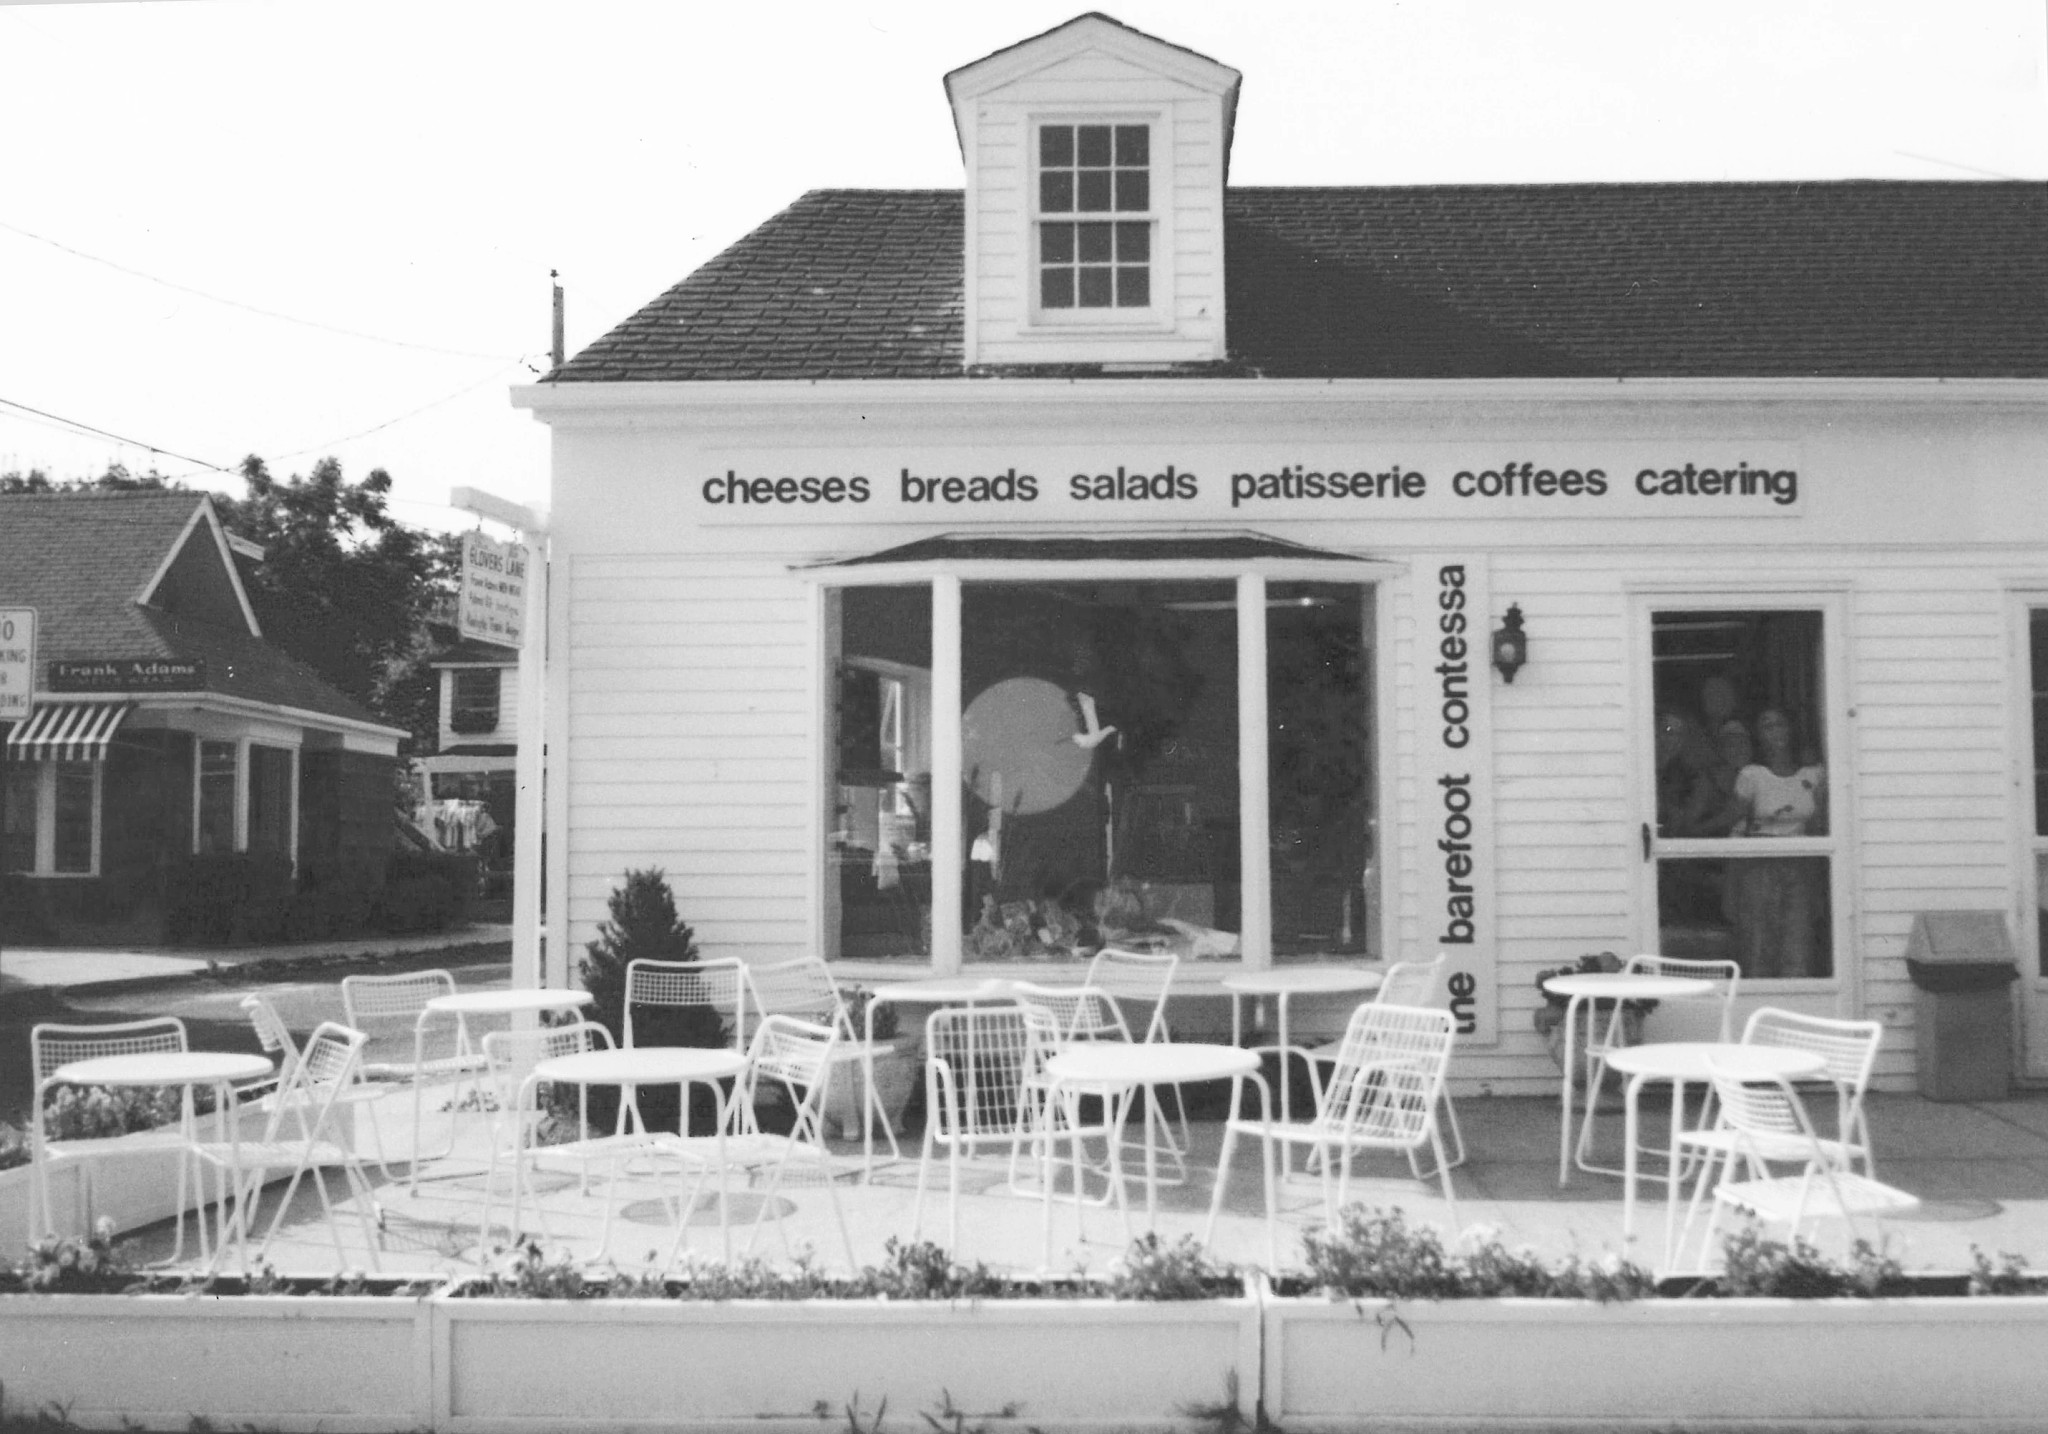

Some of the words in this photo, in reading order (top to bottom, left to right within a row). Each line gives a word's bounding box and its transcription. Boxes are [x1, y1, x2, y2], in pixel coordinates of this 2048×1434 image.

[703, 471, 870, 503] cheeses
[902, 469, 1038, 503] breads
[1070, 466, 1198, 500] salads
[1232, 465, 1426, 508] patisserie
[1453, 462, 1608, 497] coffees
[1635, 462, 1797, 505] catering
[60, 663, 117, 676] Frank
[132, 663, 195, 675] Adams
[1435, 565, 1469, 749] contessa
[1438, 774, 1475, 944] barefoot
